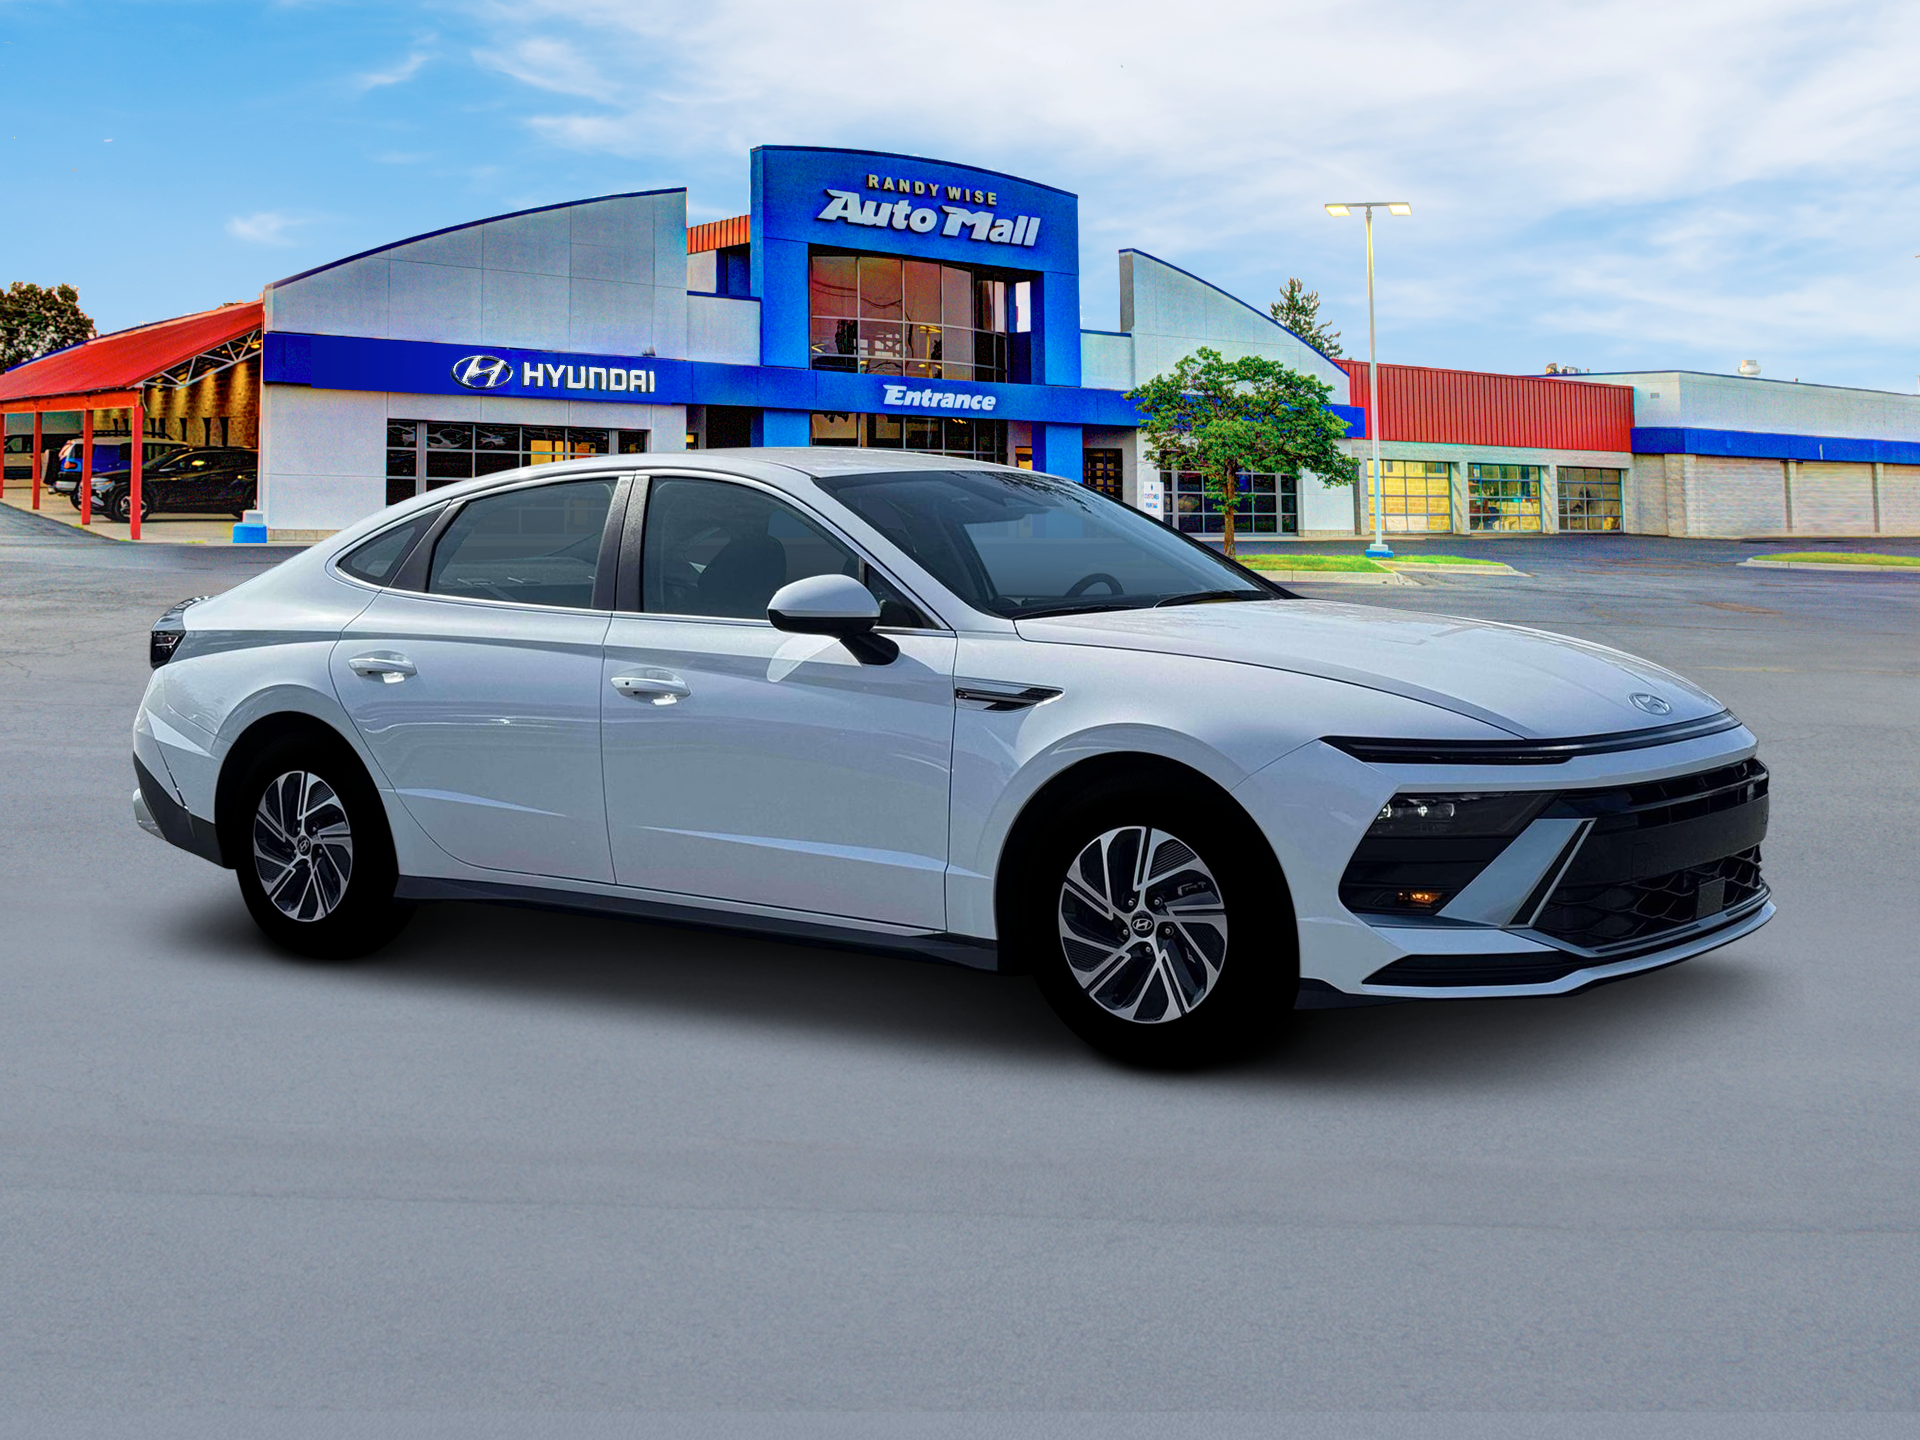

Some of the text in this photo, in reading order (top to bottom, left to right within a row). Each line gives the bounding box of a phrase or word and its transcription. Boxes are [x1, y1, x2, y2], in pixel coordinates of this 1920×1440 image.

[867, 174, 997, 205] RANDY WISE
[818, 189, 1041, 246] Auto Mall
[523, 362, 655, 393] HYUNDAI
[883, 385, 996, 410] Entrance
